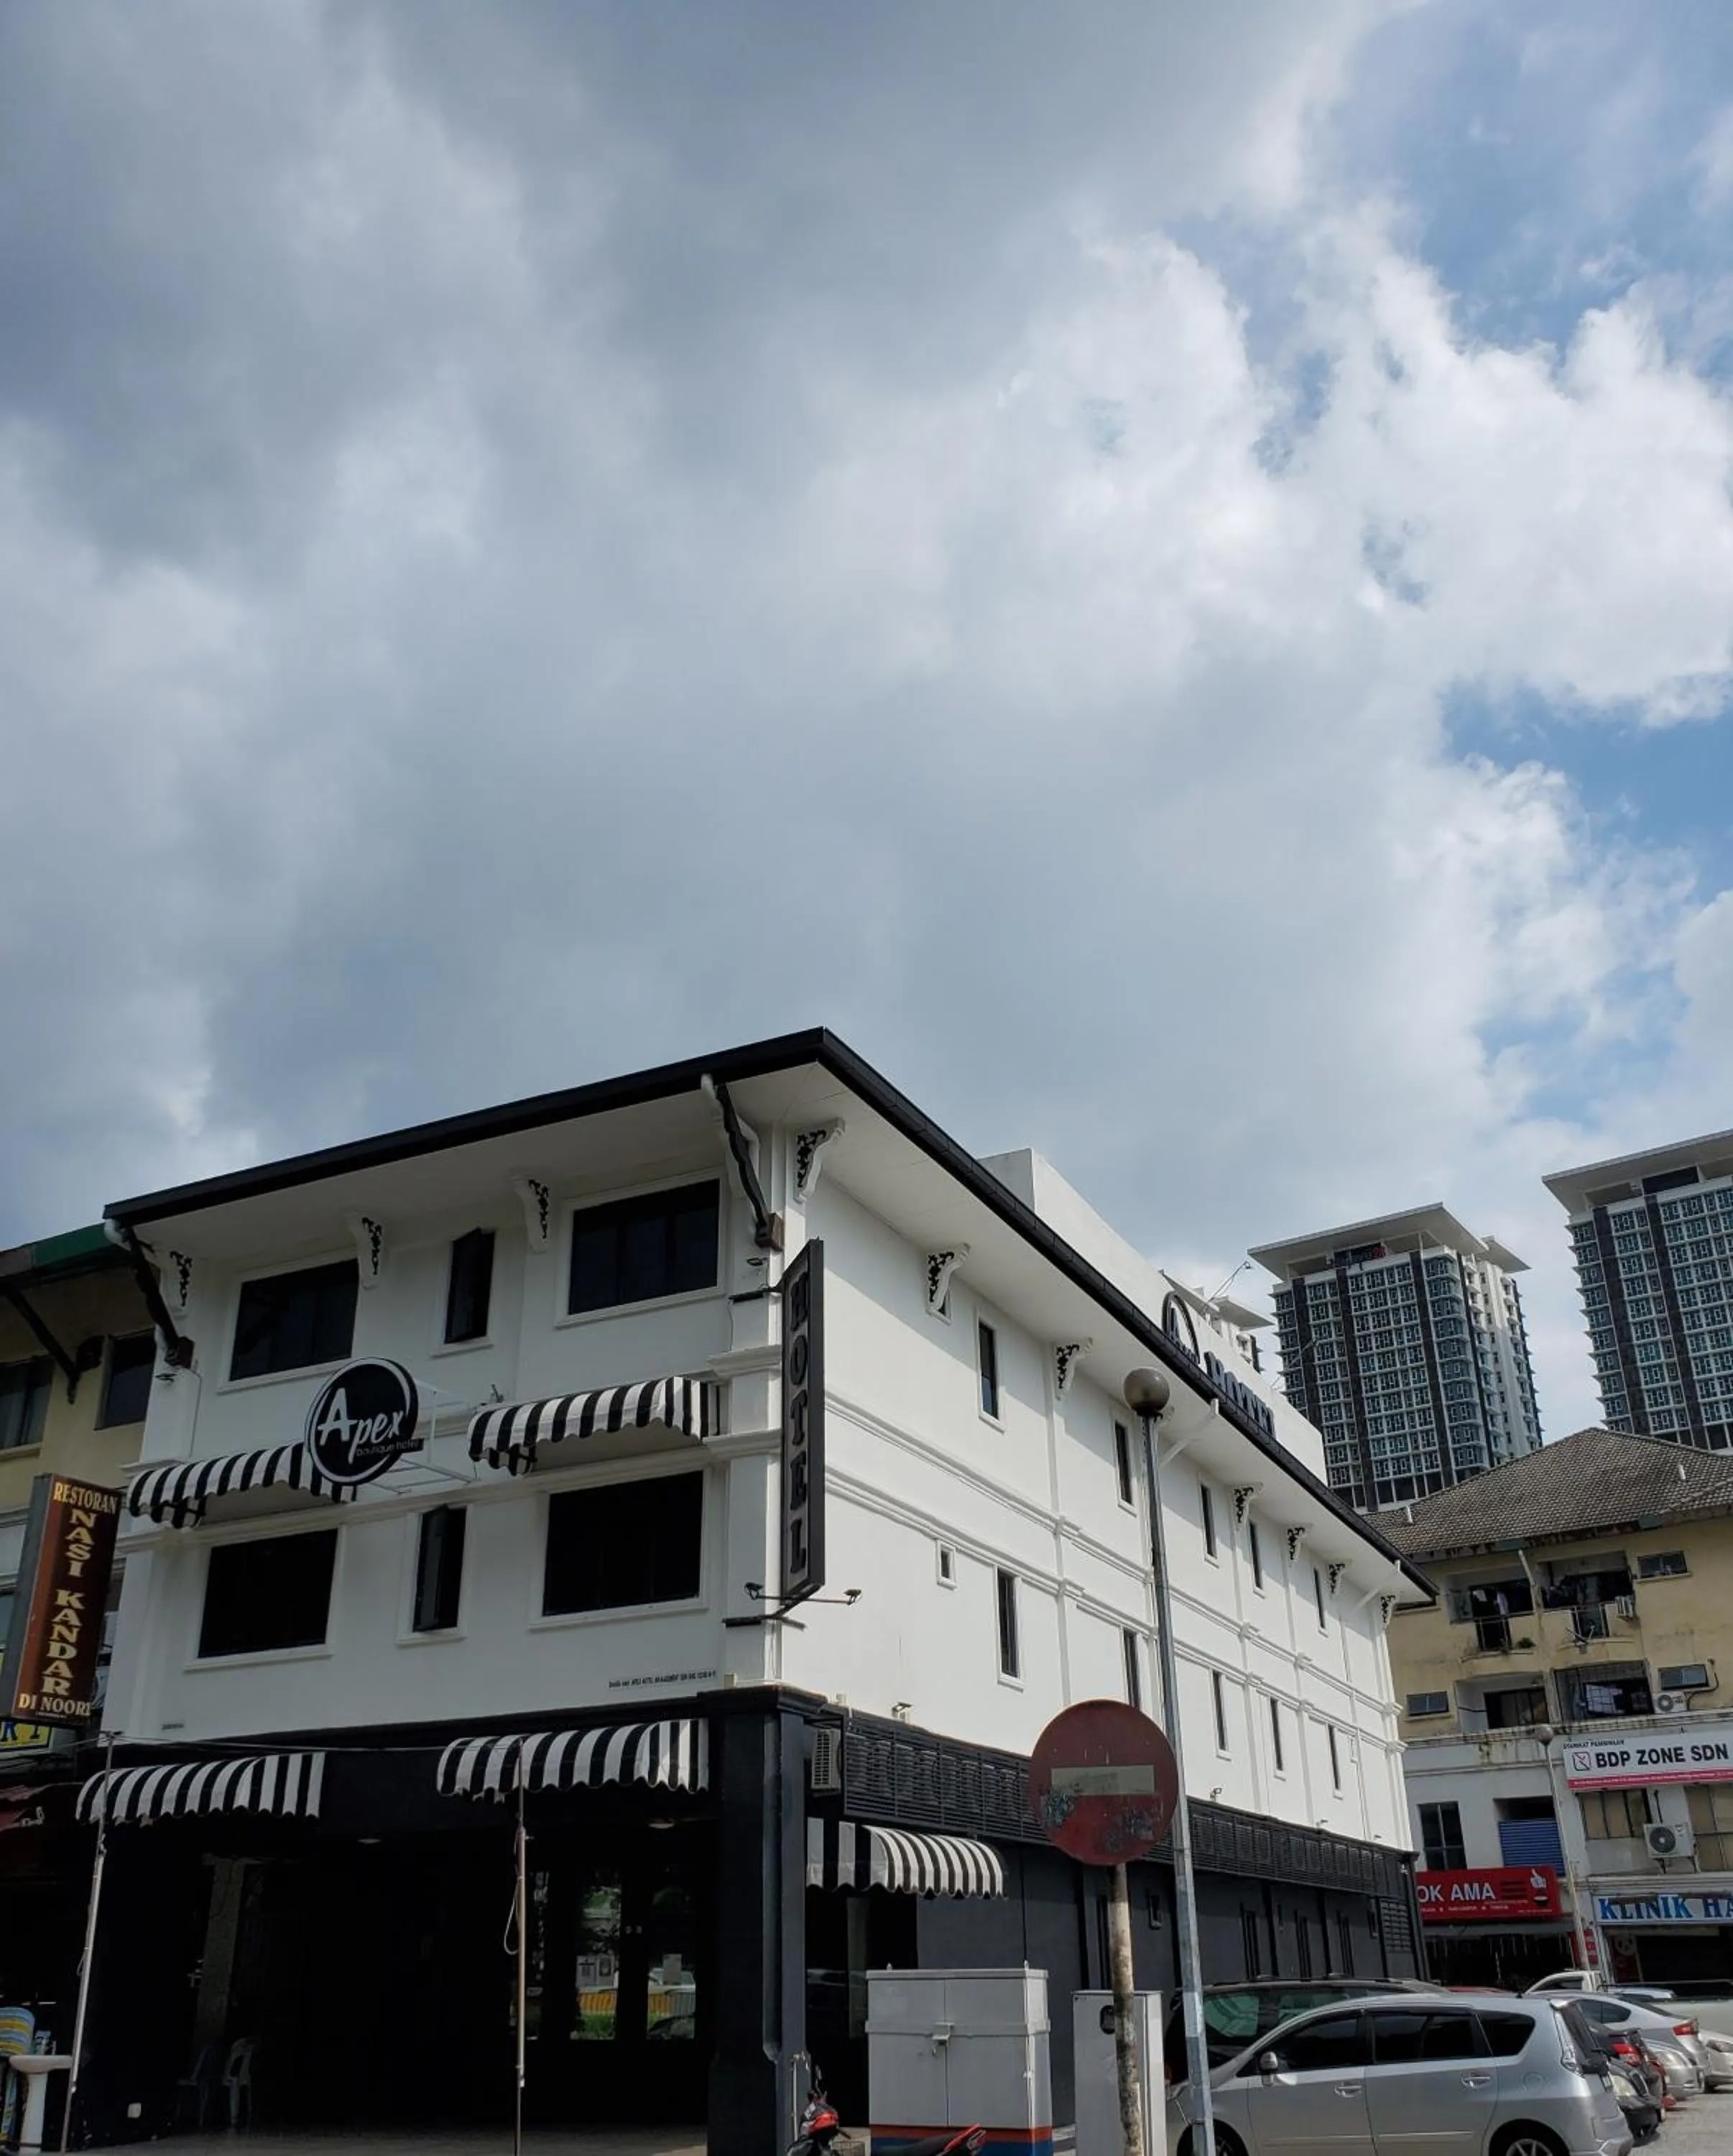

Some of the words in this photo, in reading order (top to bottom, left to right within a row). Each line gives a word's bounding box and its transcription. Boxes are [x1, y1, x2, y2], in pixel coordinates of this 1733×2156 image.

[317, 1387, 404, 1465] Apex
[790, 1271, 808, 1574] HOTEL
[53, 1481, 119, 1514] RESTORAN
[65, 1508, 97, 1577] NASI
[40, 1589, 86, 1695] KANDAR
[1595, 1751, 1631, 1769] BDP
[1636, 1746, 1686, 1766] ZONE
[1691, 1743, 1729, 1761] SDN
[1451, 1881, 1496, 1902] AMA
[1598, 1896, 1693, 1920] KLINIK
